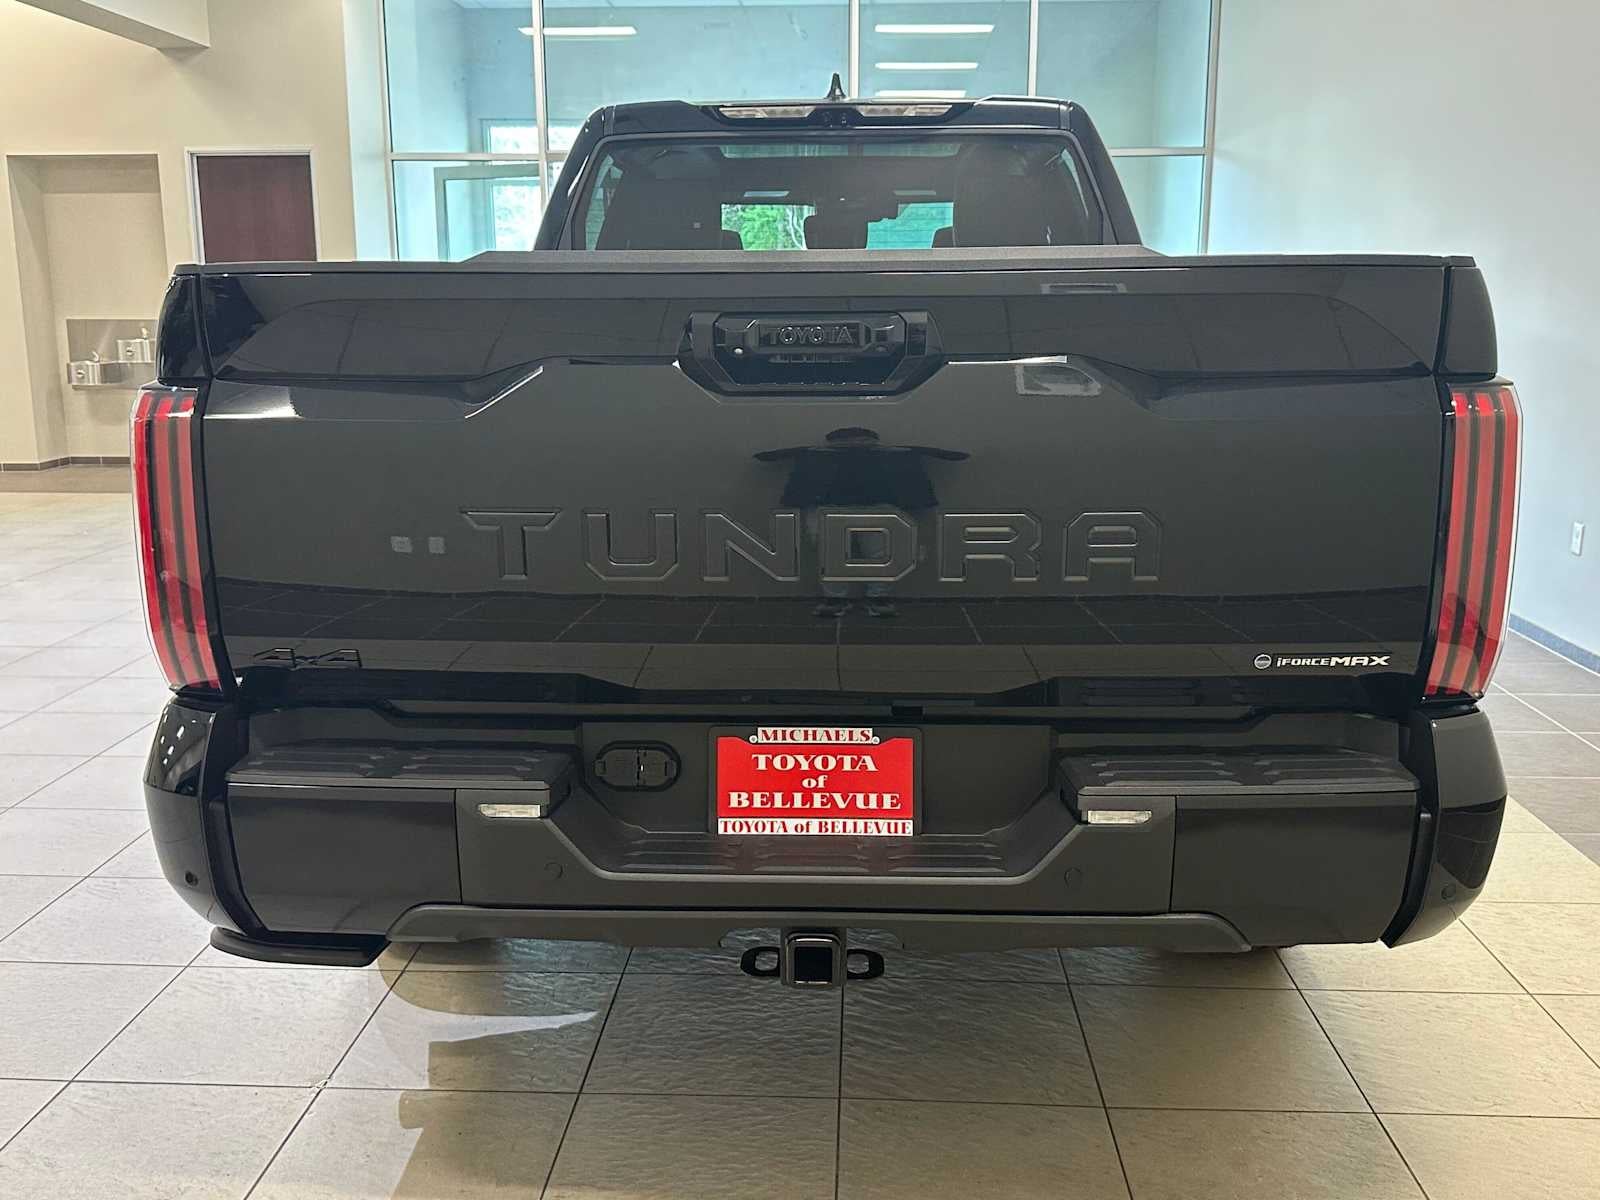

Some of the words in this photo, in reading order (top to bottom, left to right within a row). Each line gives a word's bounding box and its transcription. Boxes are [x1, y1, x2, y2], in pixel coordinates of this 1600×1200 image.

[767, 326, 852, 344] TOYOTA
[460, 508, 1164, 585] TUNDRA
[760, 729, 871, 742] MICHAELS
[751, 754, 879, 772] TOYOTA
[802, 775, 829, 789] of
[728, 792, 901, 810] BELLEVUE
[720, 820, 788, 834] TOYOTA
[794, 820, 813, 834] of
[818, 820, 912, 835] BELLEVUE
